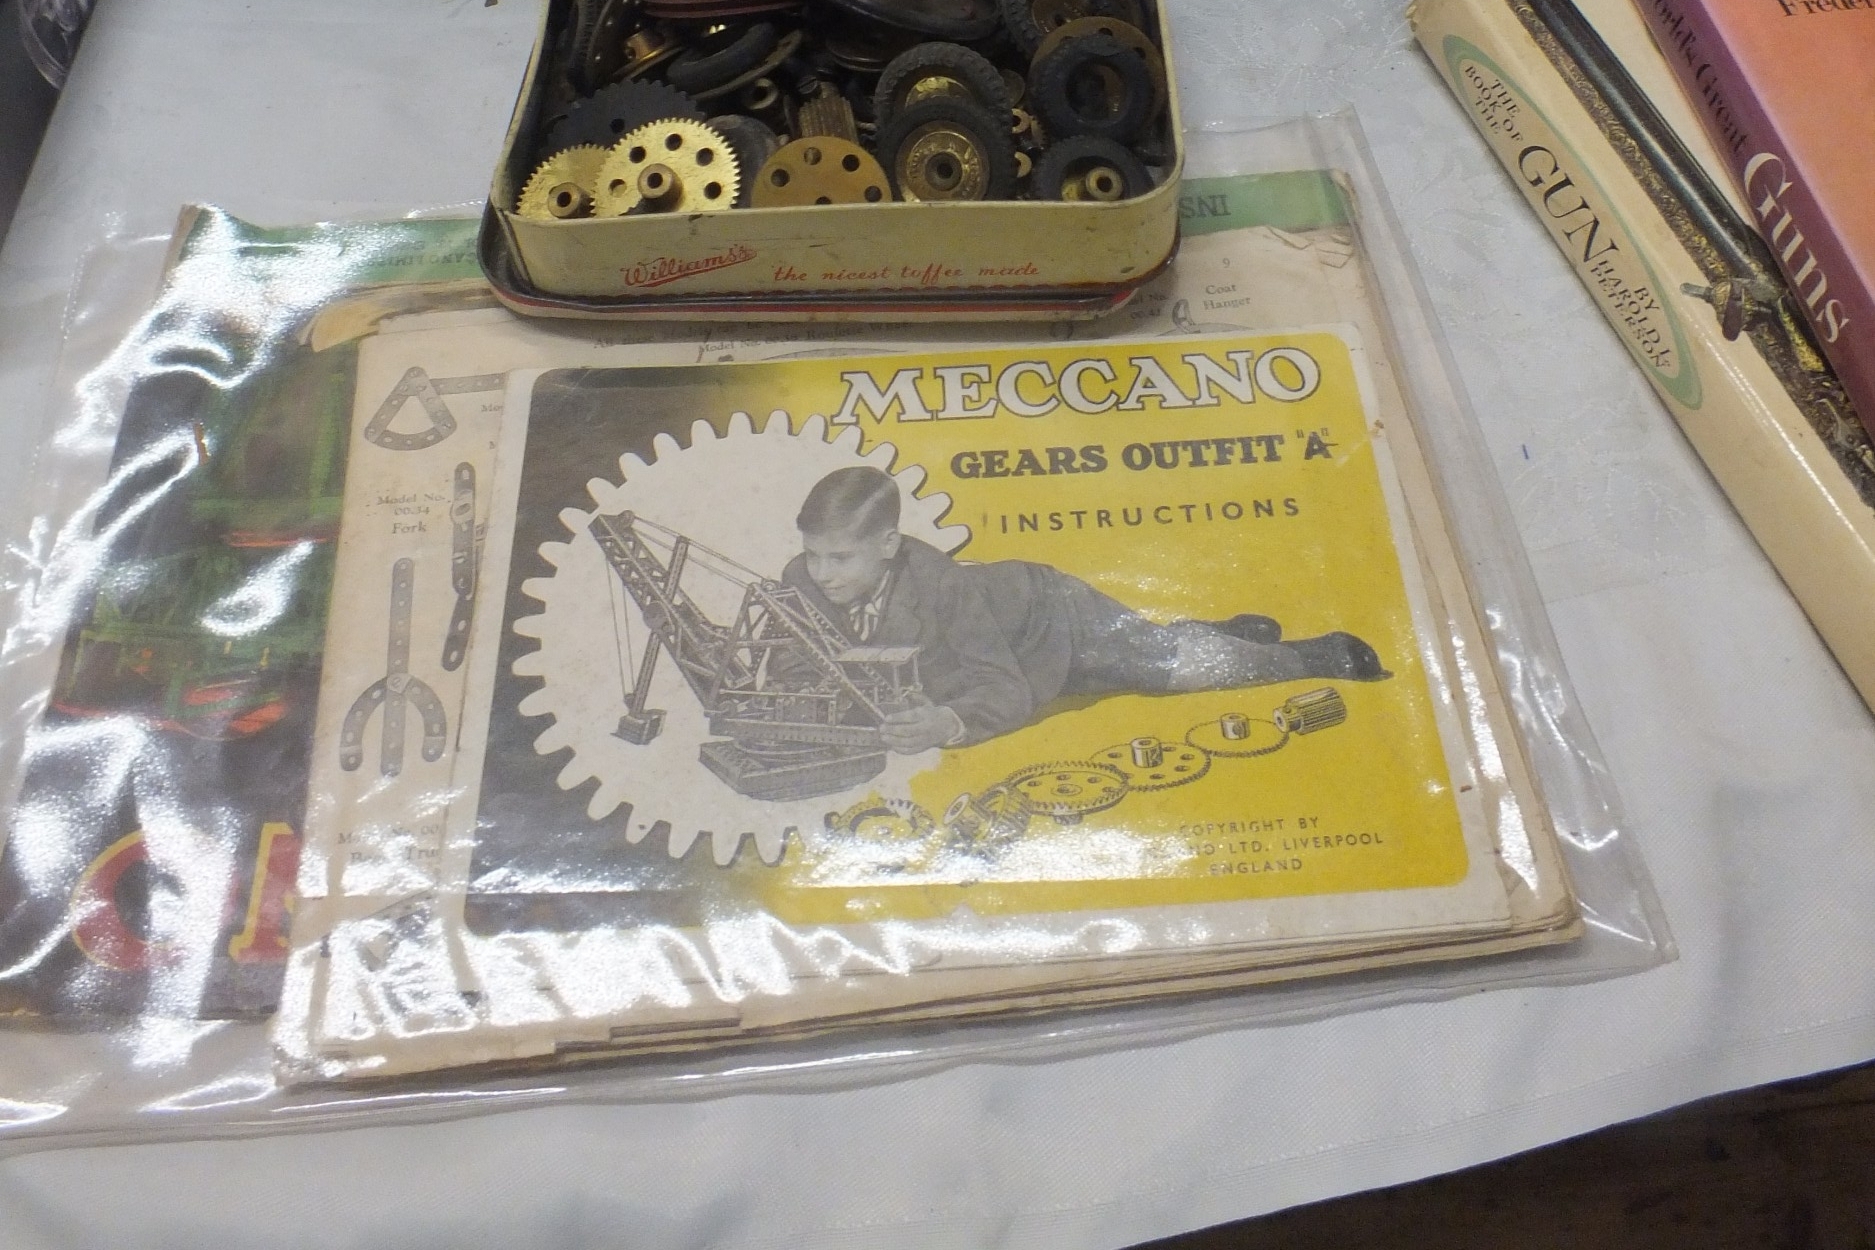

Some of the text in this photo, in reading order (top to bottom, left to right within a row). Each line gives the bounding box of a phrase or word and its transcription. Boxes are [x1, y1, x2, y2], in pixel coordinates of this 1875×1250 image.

[1464, 66, 1524, 143] BOOK OF
[1489, 78, 1521, 118] THE
[1475, 95, 1500, 135] THE
[1517, 145, 1620, 263] GUN
[1695, 63, 1748, 152] Great
[1744, 152, 1850, 343] Guns
[774, 261, 1040, 285] the nicest toffee made
[1203, 297, 1251, 311] Hanger
[1204, 283, 1238, 296] Coat
[1598, 260, 1661, 344] HAROLD
[1634, 287, 1660, 311] BY
[1590, 267, 1665, 368] PETERSON
[830, 346, 1322, 425] MECCANO
[949, 443, 1109, 480] GEARS
[1121, 434, 1285, 472] OUTFIT
[376, 492, 446, 506] Model No.
[393, 506, 431, 517] 00.34
[391, 521, 428, 535] Fork
[1001, 497, 1301, 535] INSTRUCTIONS
[1178, 816, 1320, 838] COPYRIGHT BY
[1229, 839, 1270, 855] LTD.
[1282, 831, 1385, 851] LIVERPOOL
[1209, 857, 1304, 877] ENGLAND
